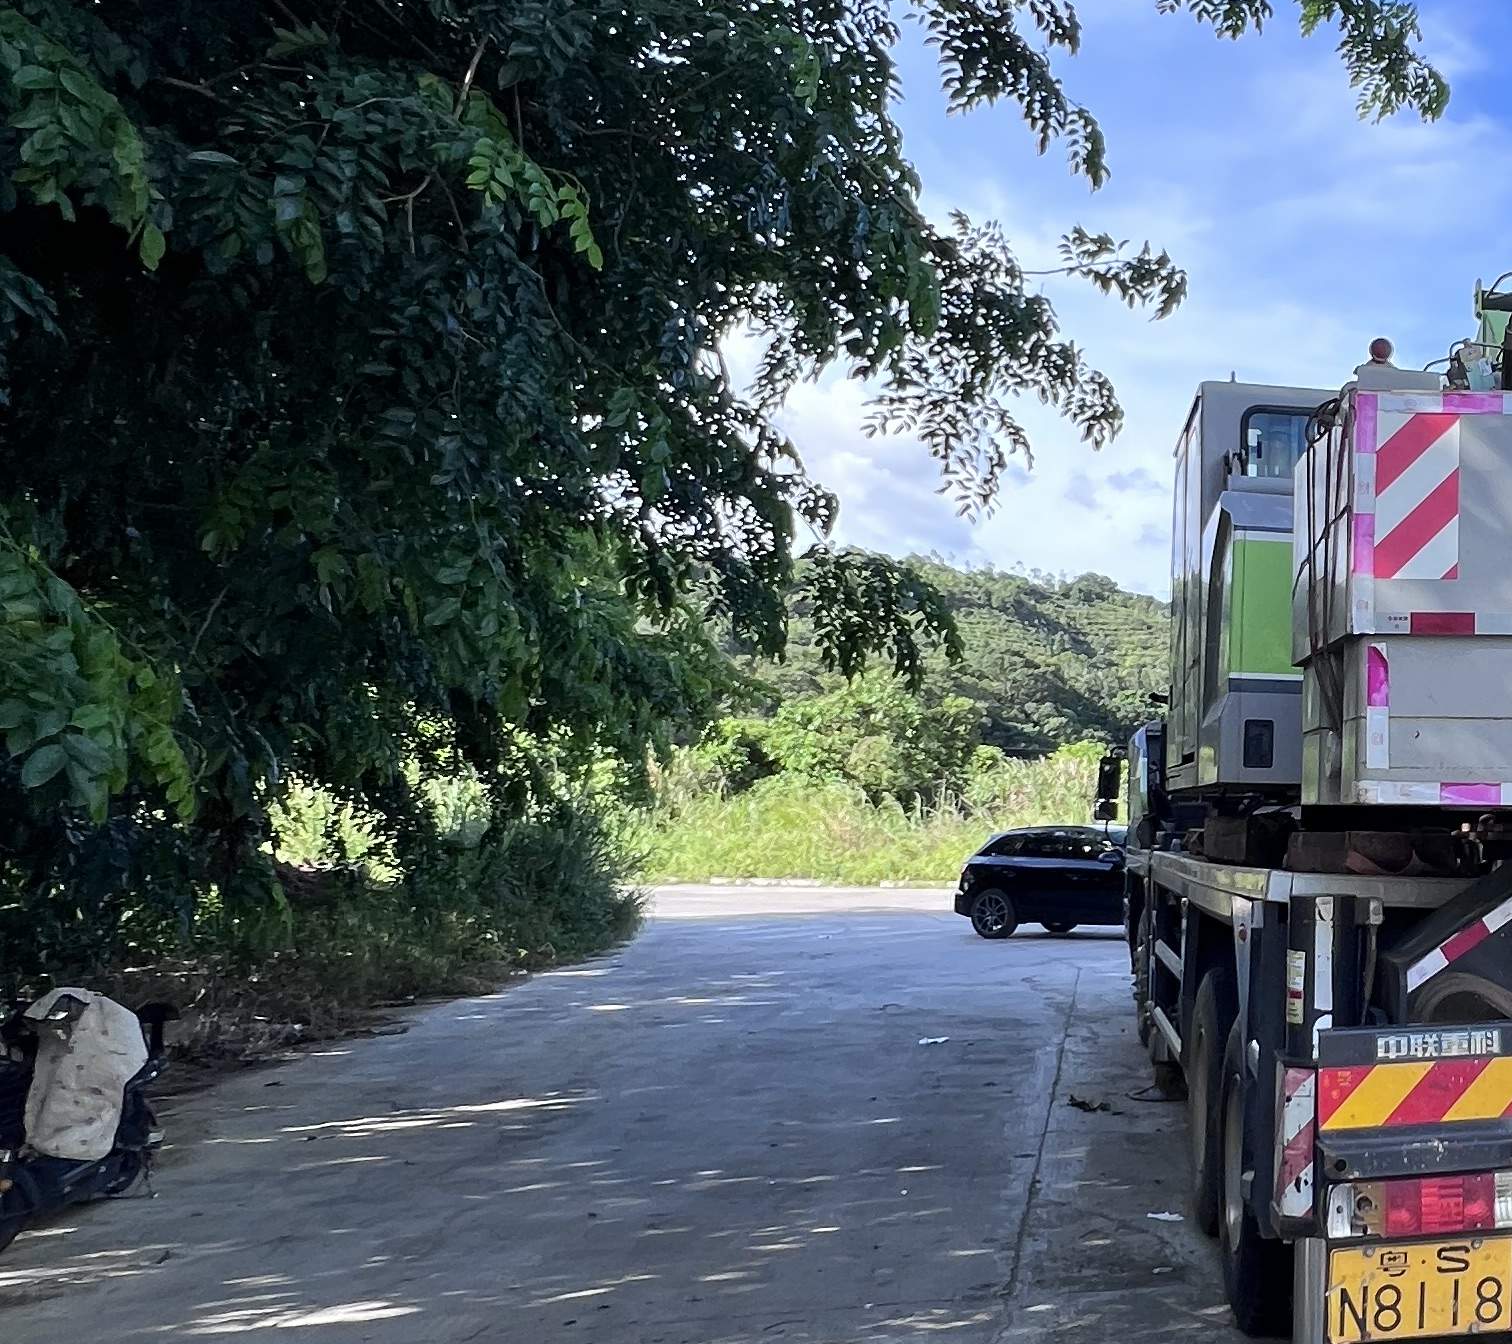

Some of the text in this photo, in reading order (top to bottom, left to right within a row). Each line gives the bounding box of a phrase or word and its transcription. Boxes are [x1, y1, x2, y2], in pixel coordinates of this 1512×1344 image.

[1376, 1030, 1501, 1059] 中联重科
[1338, 1276, 1503, 1338] N8118
